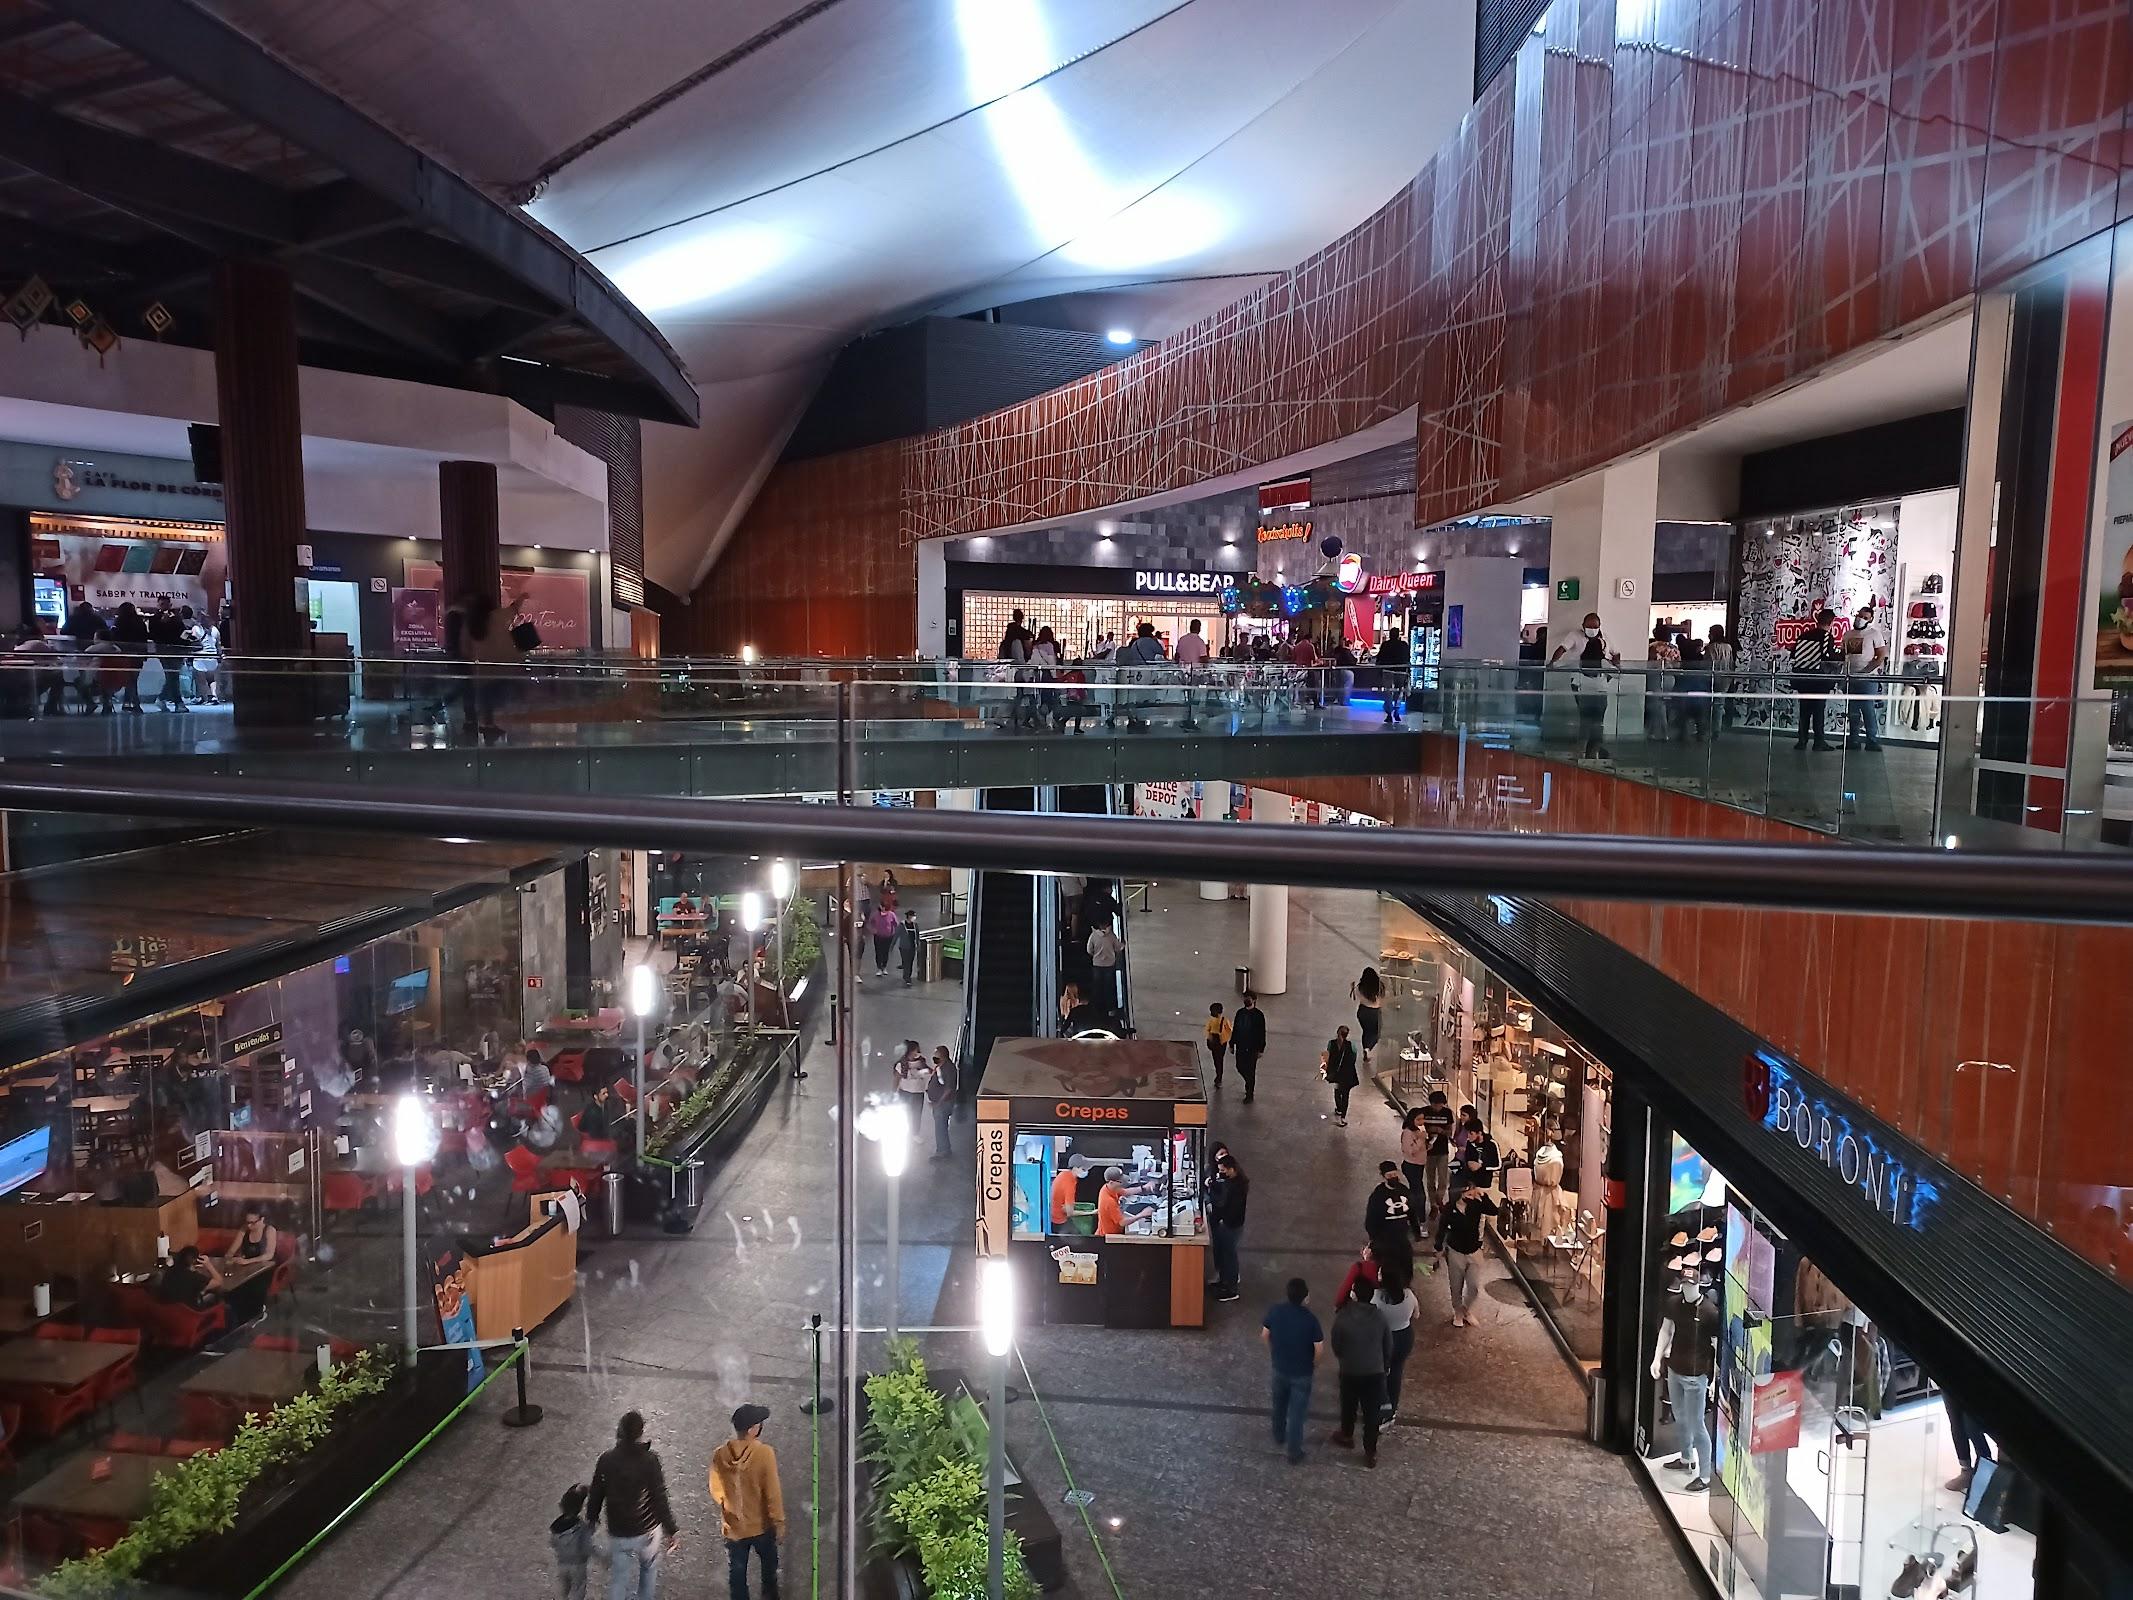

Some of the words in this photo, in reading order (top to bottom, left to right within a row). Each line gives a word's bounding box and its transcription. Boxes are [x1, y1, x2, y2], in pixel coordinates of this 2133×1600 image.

[86, 477, 105, 487] LA
[111, 480, 152, 492] FLOR
[158, 484, 177, 493] DE
[1369, 575, 1397, 593] Dairy
[1399, 572, 1433, 590] Queen
[96, 590, 126, 598] SABOR
[130, 590, 136, 598] Y
[1145, 789, 1176, 805] DEPOT
[1055, 1102, 1129, 1121] Crepas
[986, 1129, 1007, 1201] Crepas
